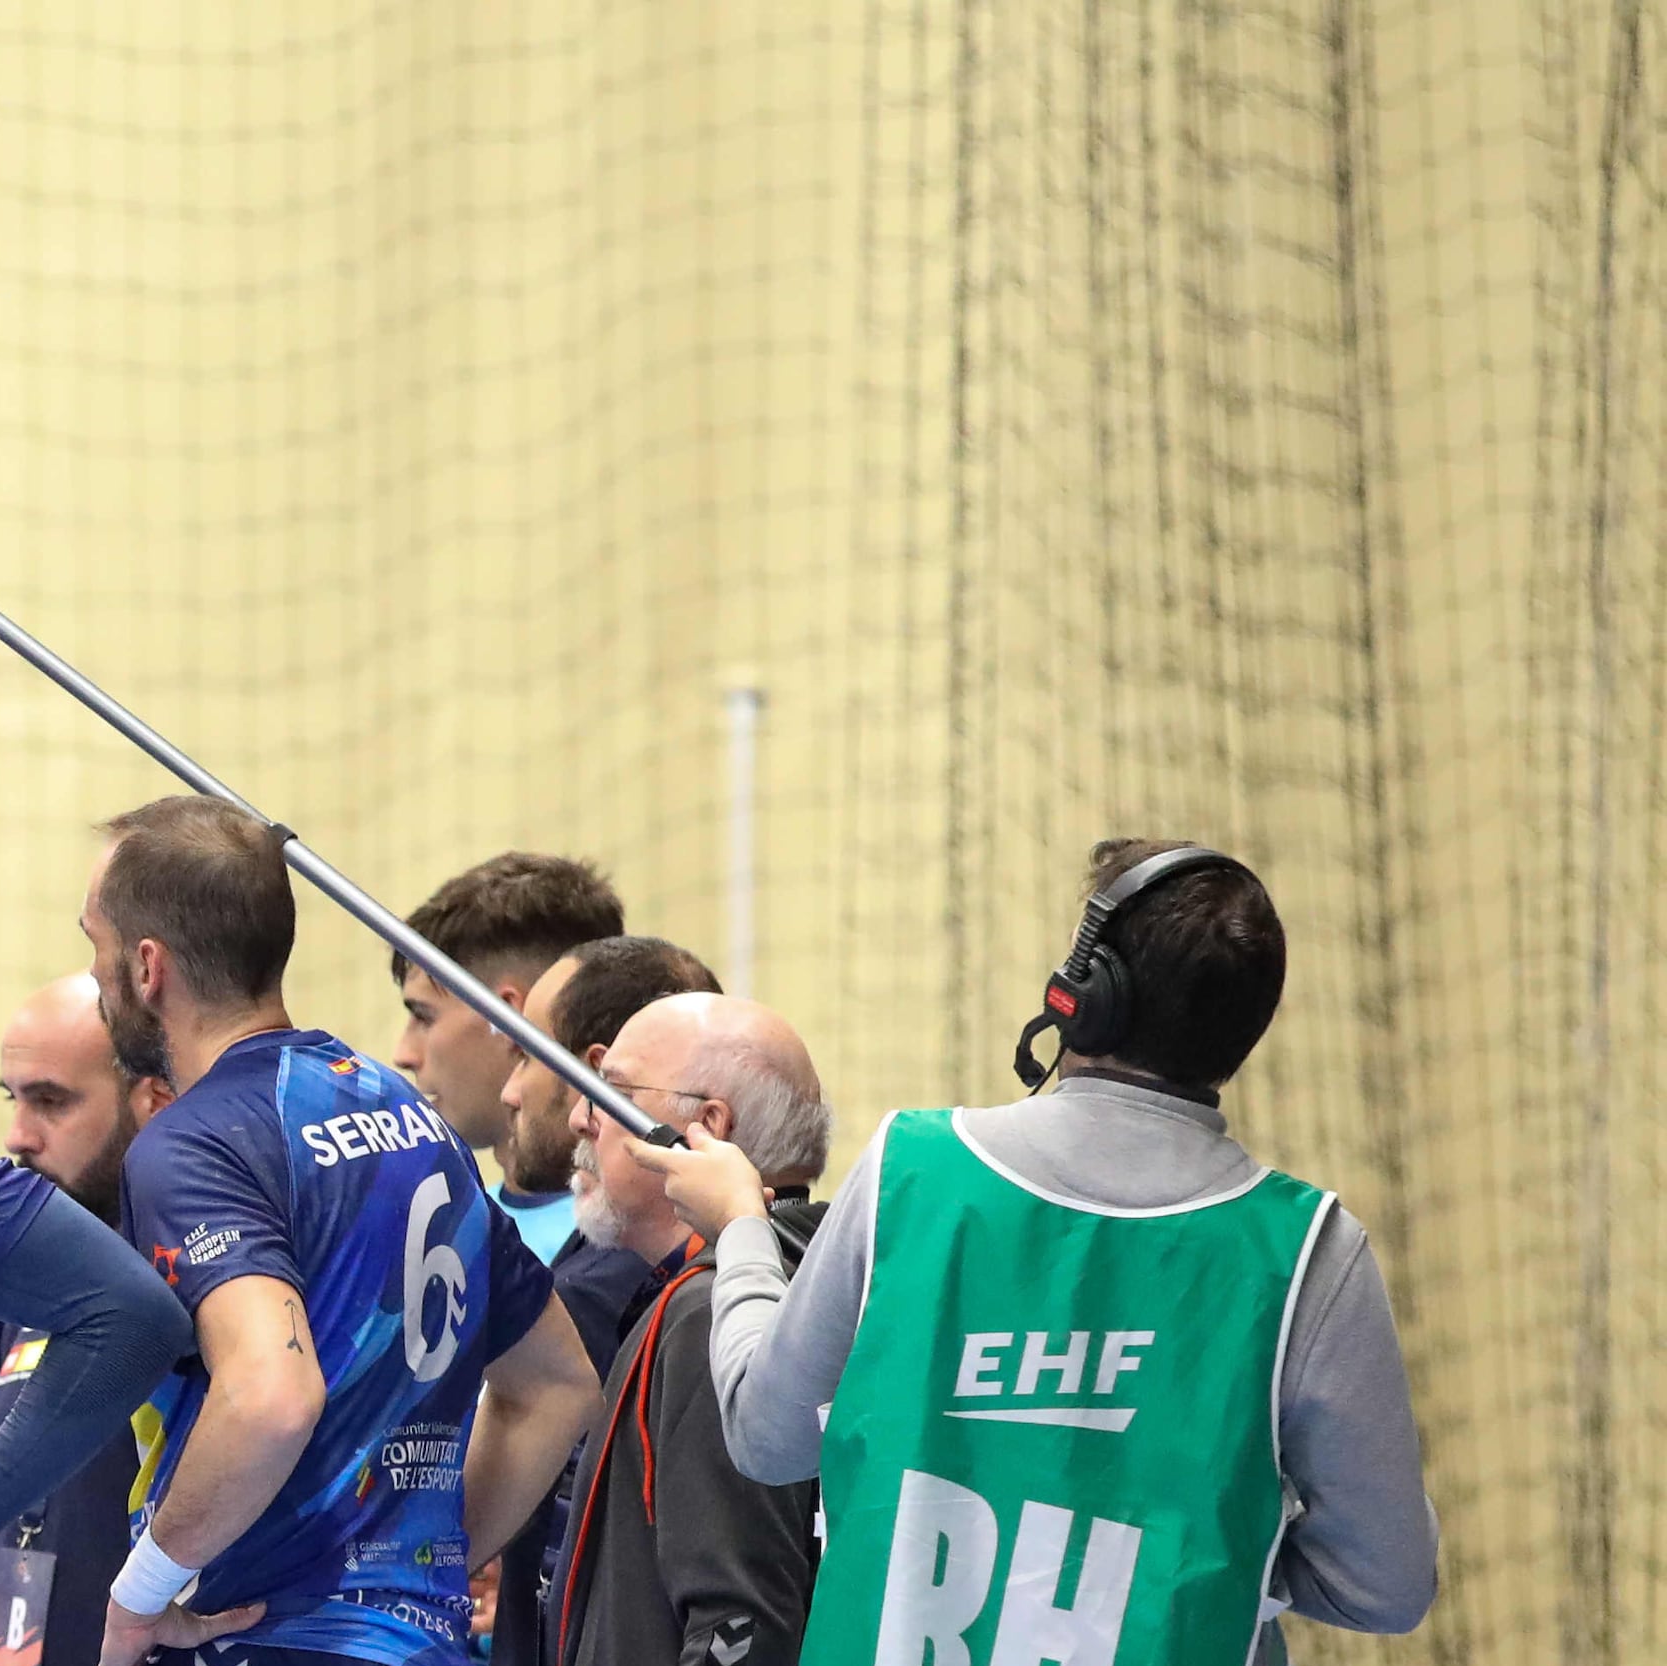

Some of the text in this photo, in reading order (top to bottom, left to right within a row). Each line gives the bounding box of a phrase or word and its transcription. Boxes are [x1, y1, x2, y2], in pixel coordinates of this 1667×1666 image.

[301, 1101, 458, 1167] SERRAN
[188, 1230, 241, 1258] EUROPEAN
[191, 1243, 228, 1265] LEAGUE
[404, 1172, 467, 1383] 6
[954, 1331, 1156, 1397] EHF
[381, 1441, 459, 1467] COMUNITAT
[390, 1468, 461, 1491] DE L'ESPORT
[6, 1597, 28, 1650] B
